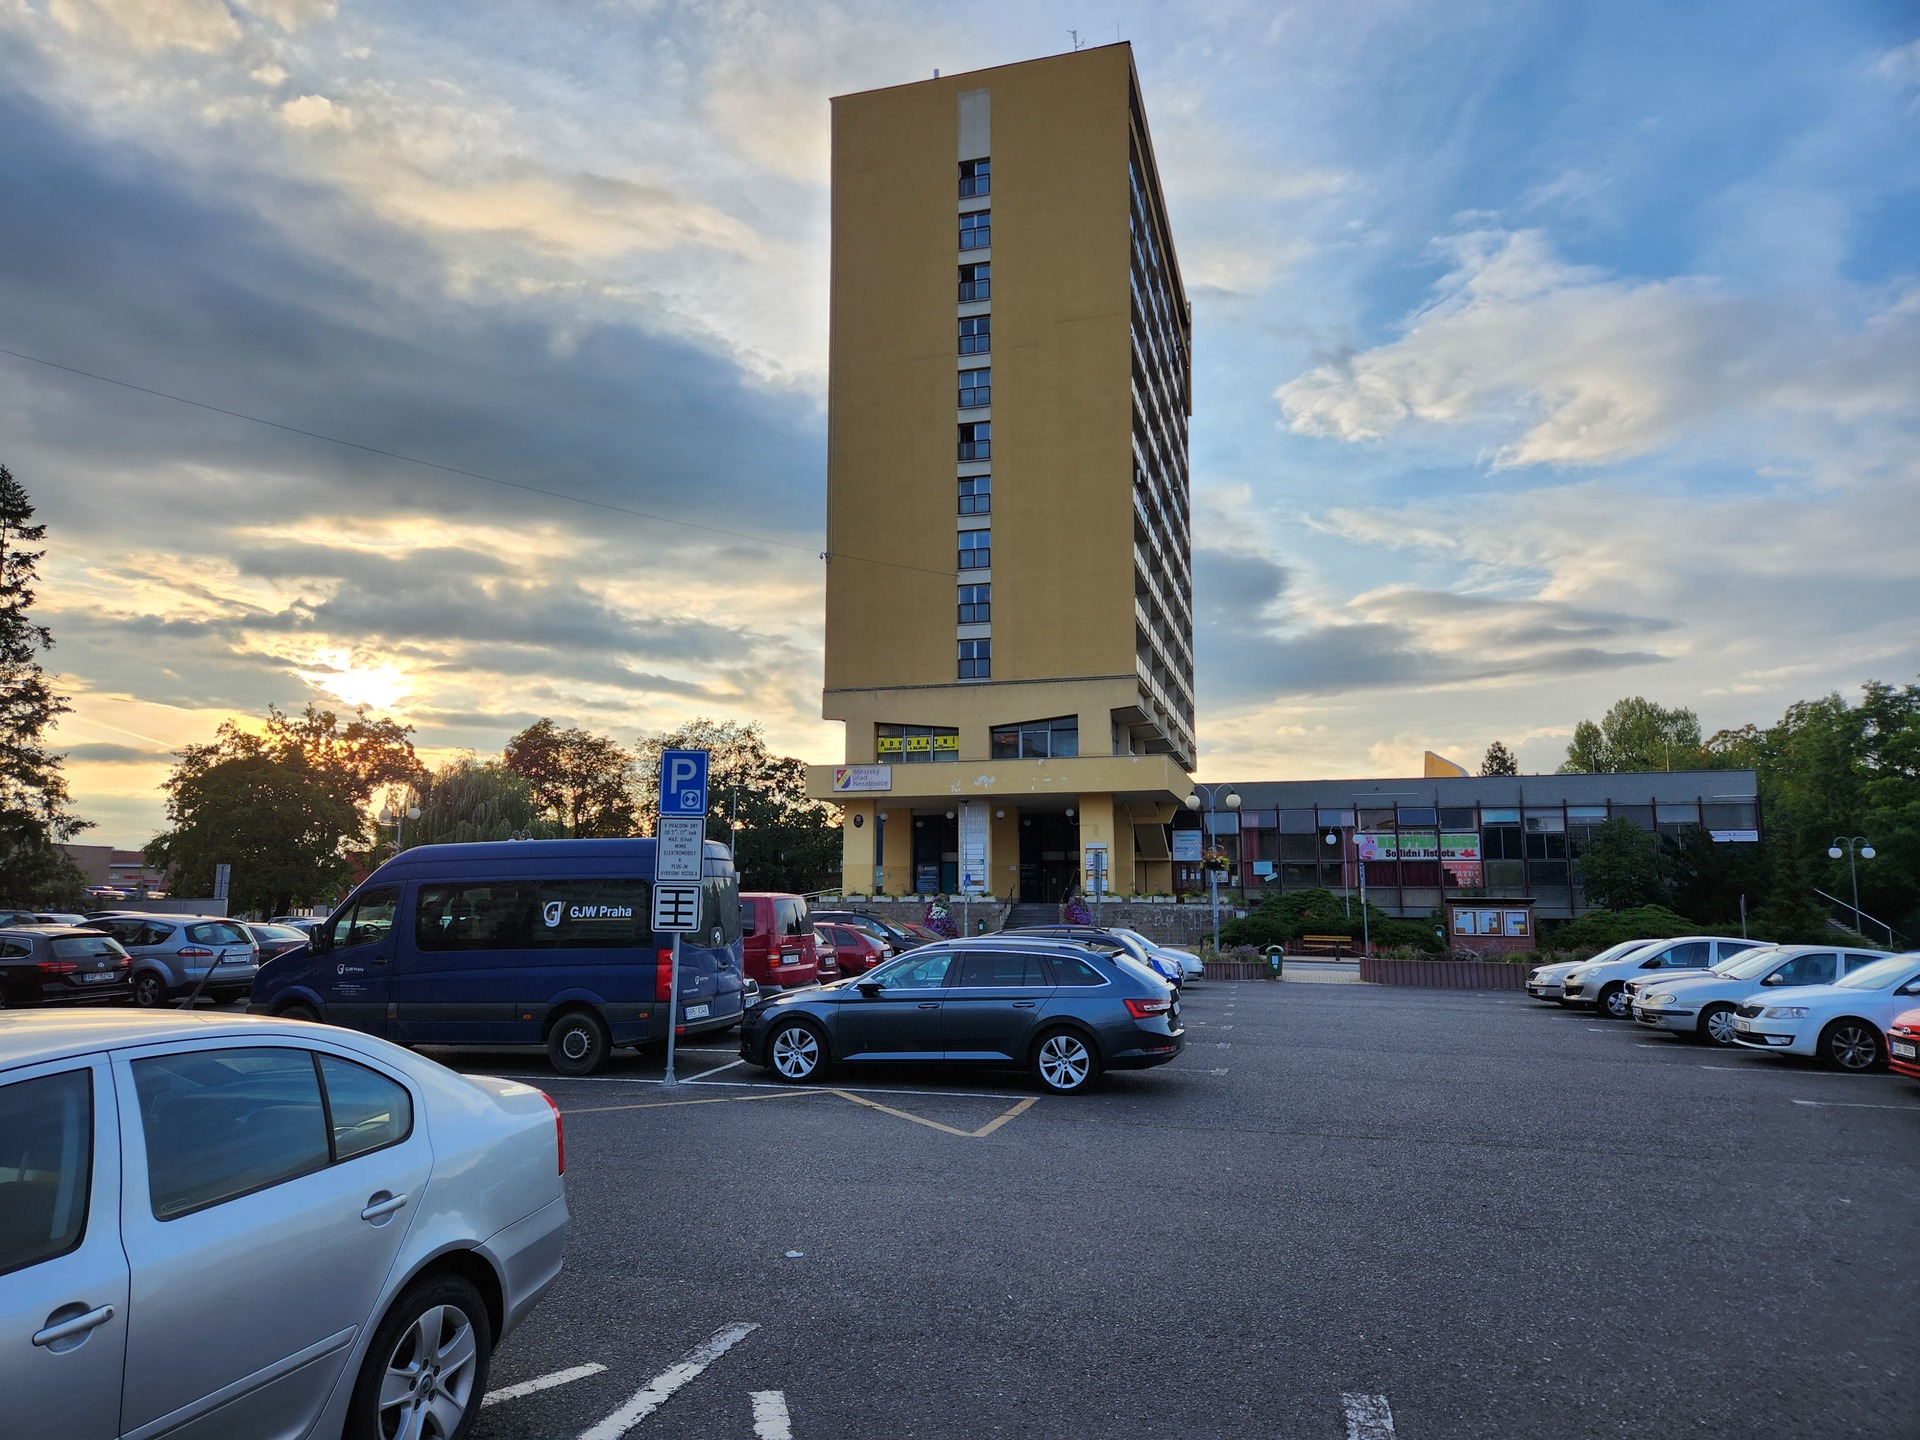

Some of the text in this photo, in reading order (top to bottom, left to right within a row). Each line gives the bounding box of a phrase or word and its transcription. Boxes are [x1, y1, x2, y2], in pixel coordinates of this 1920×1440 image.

[670, 758, 697, 794] P
[852, 768, 881, 776] Městský
[570, 905, 632, 918] GJW Praha
